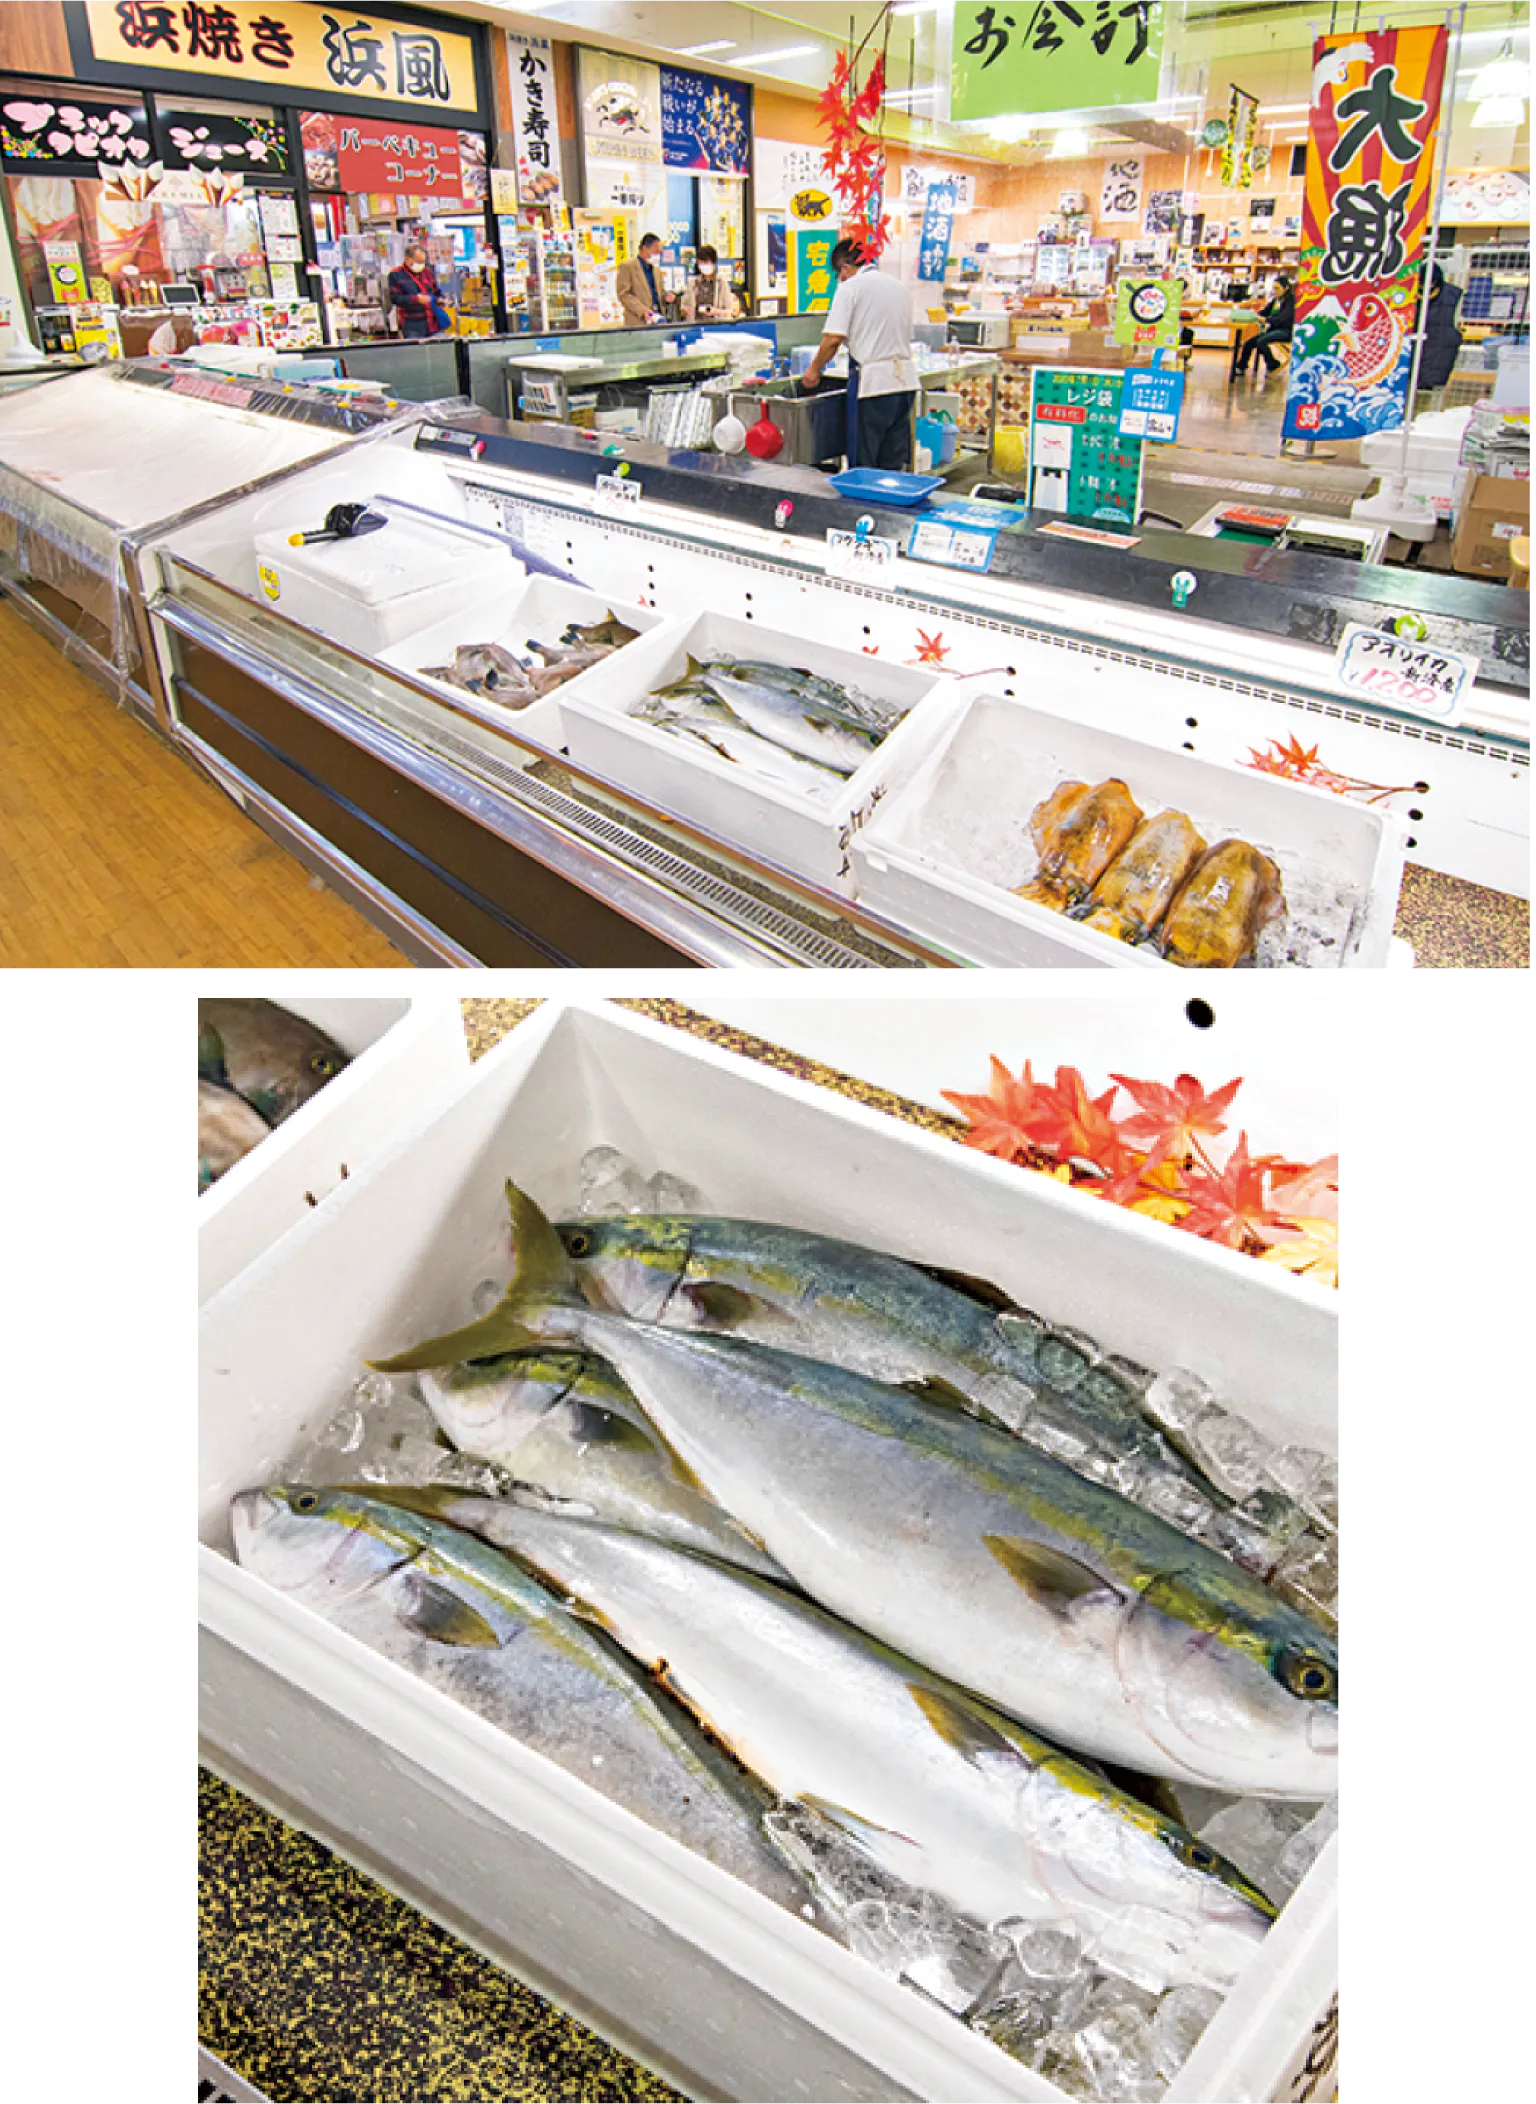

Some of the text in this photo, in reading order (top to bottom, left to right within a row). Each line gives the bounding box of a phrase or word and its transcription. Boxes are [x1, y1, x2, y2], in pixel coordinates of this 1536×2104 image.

[116, 0, 451, 101] 浜焼き 浜風
[963, 0, 1159, 69] お会計
[519, 48, 550, 168] かき寿司
[340, 128, 456, 160] バーベキュー
[385, 161, 457, 185] コーナー
